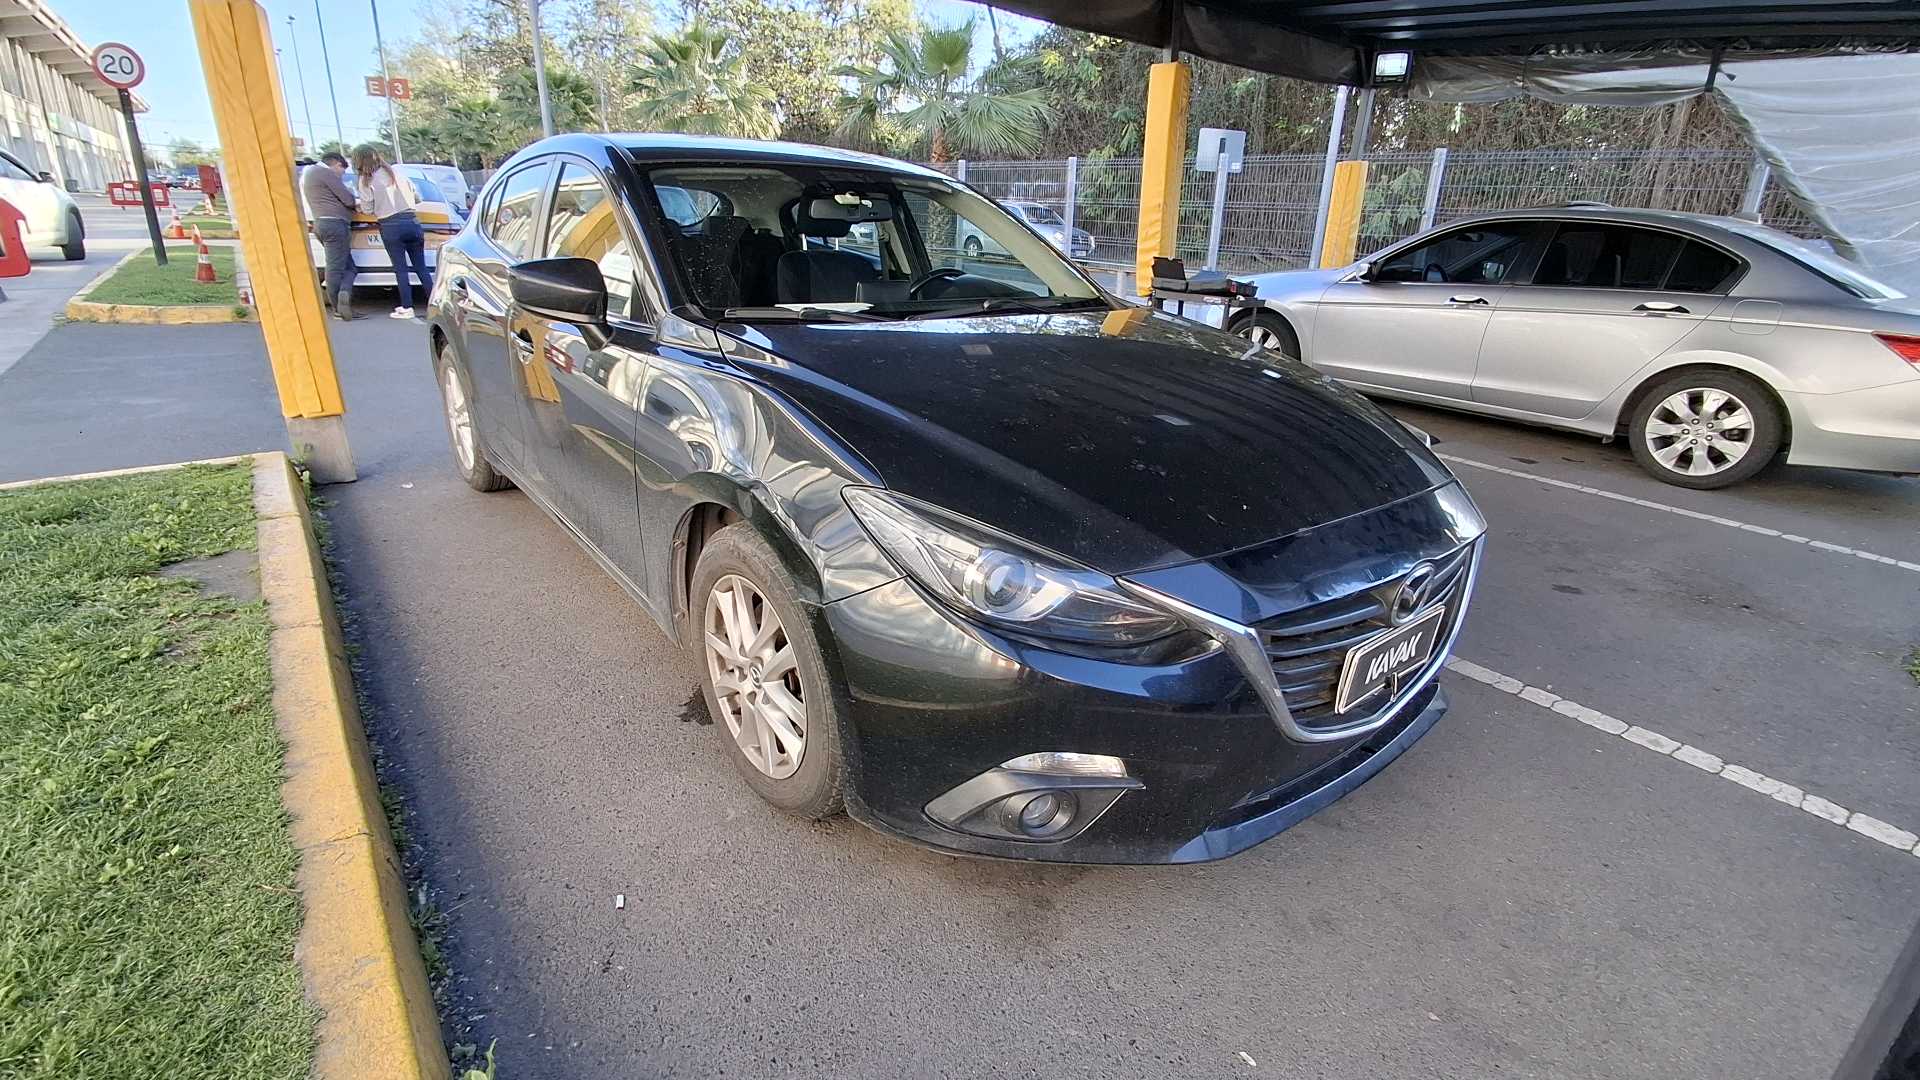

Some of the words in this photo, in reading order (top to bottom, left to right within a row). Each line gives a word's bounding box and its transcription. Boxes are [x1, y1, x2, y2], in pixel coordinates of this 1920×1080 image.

[101, 54, 134, 76] 20
[368, 81, 380, 95] E
[393, 82, 404, 96] 3
[1364, 631, 1423, 685] KAVAK
